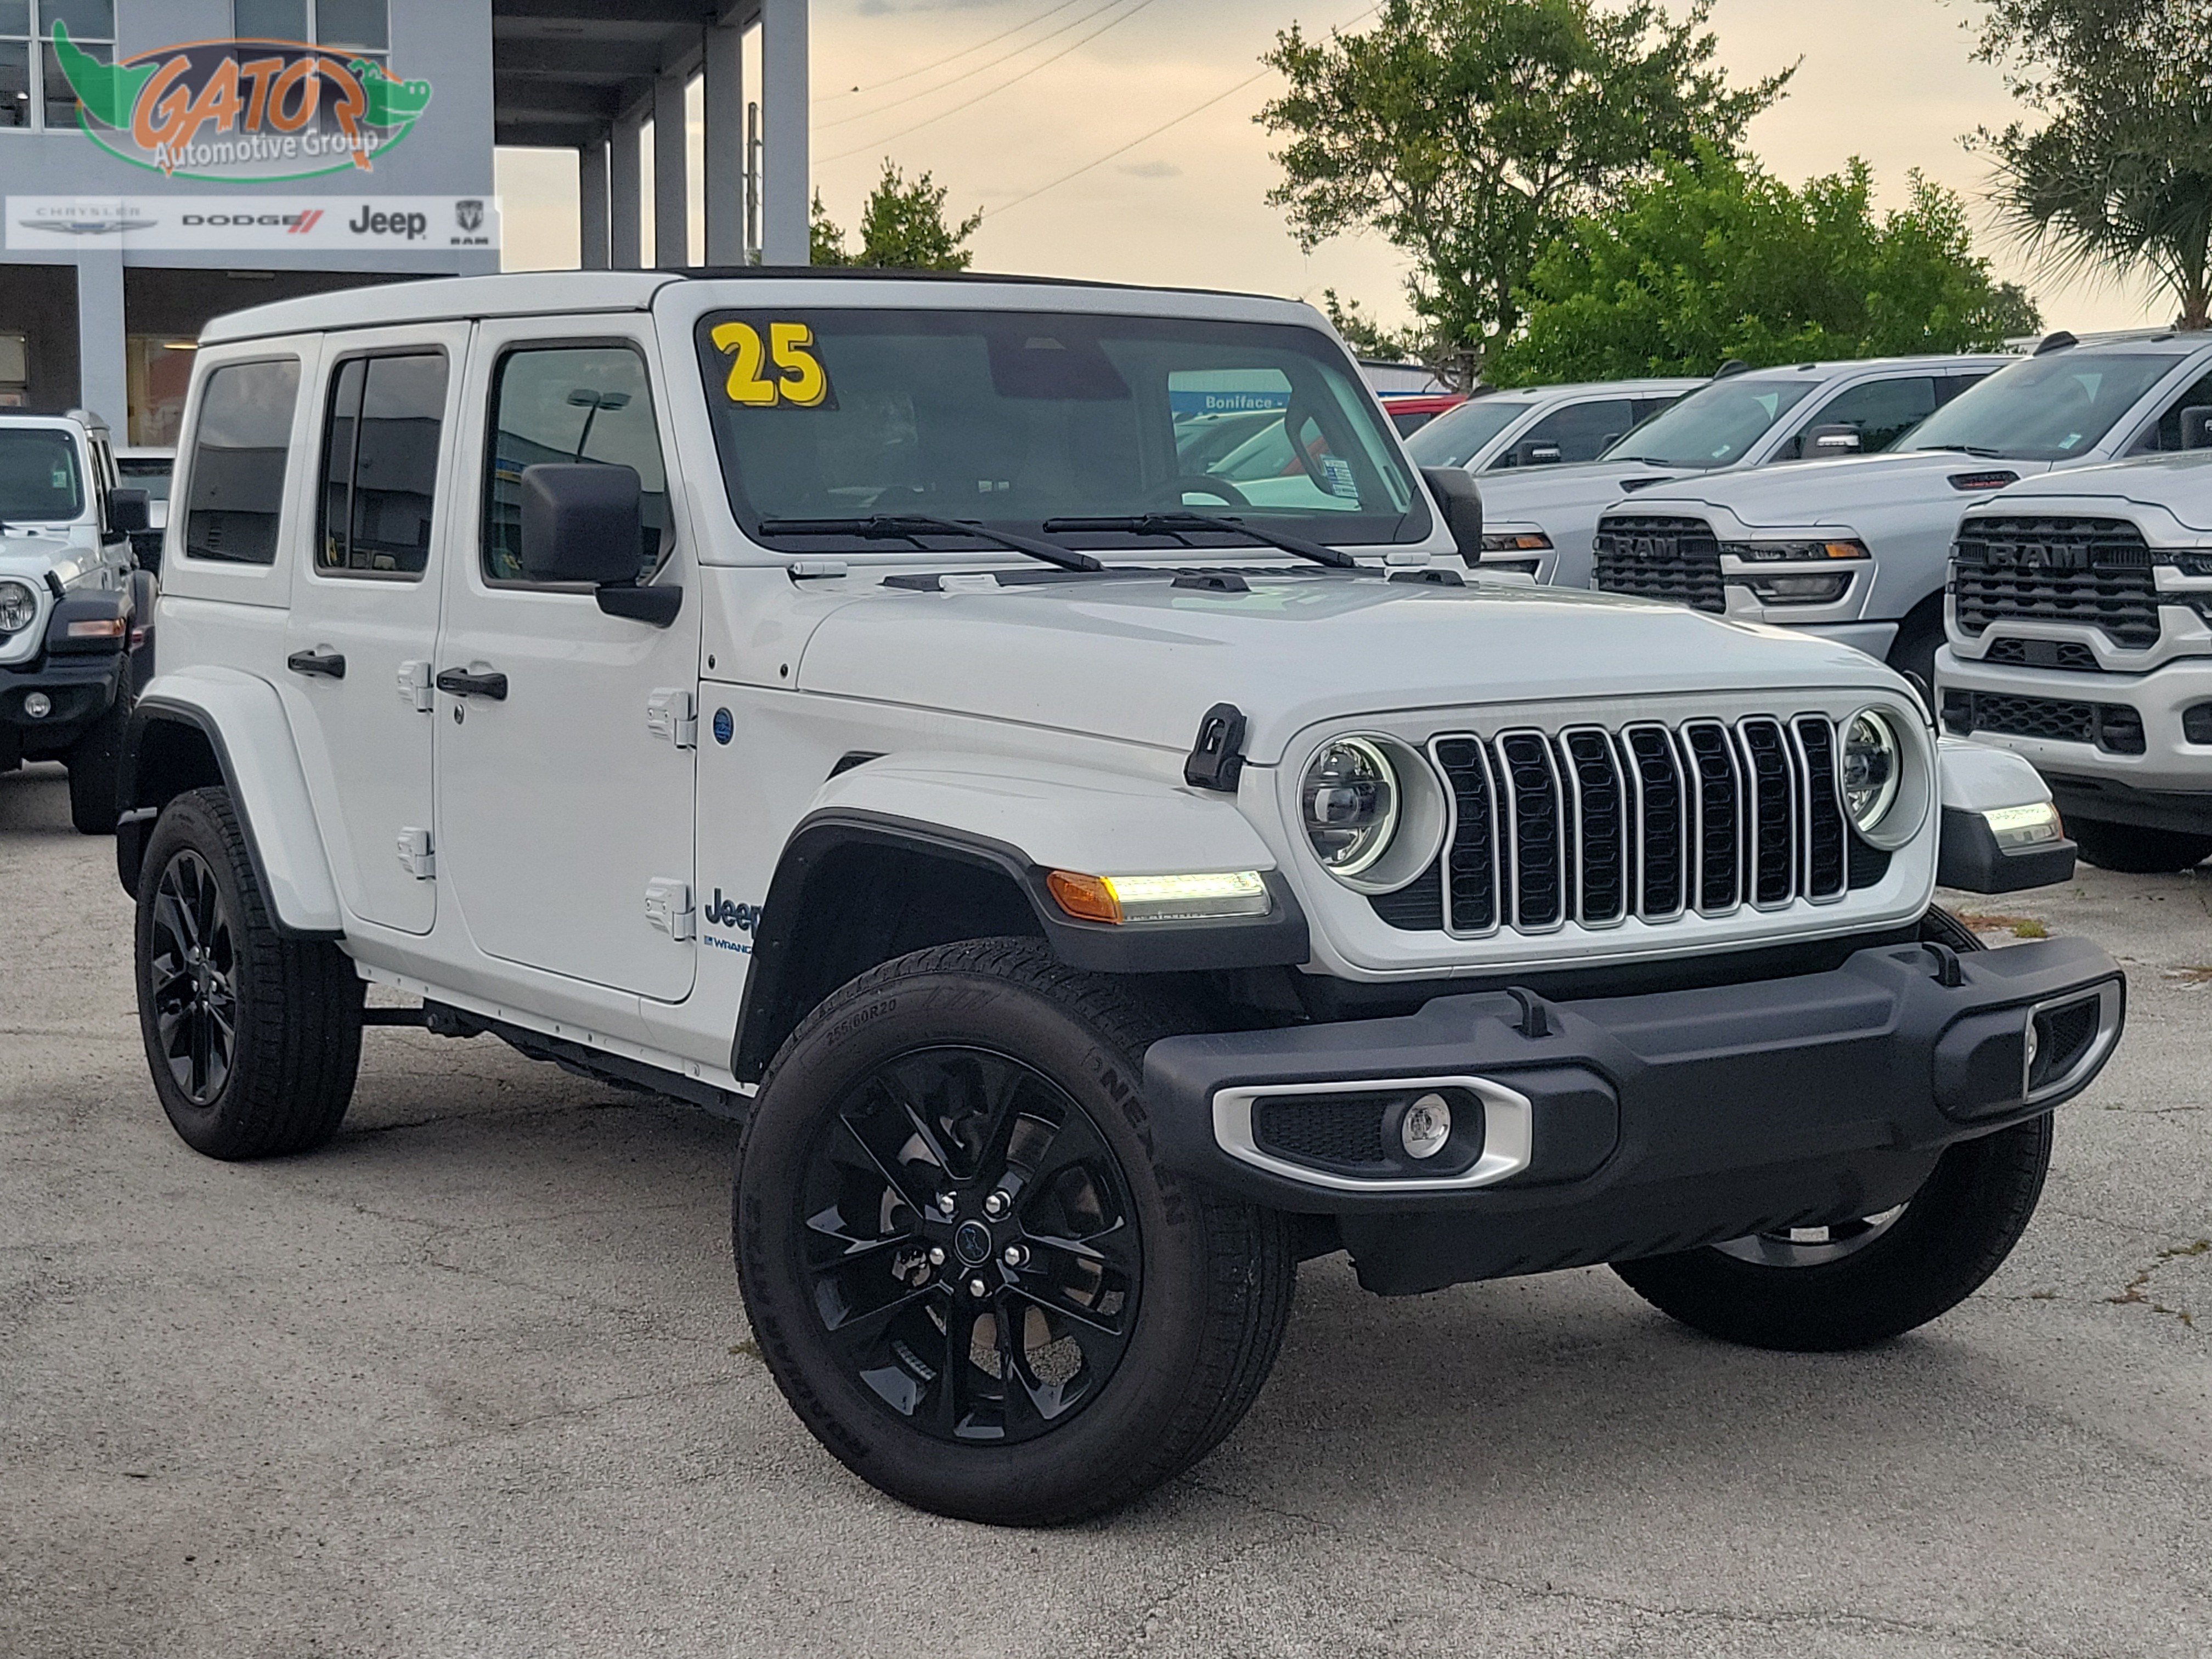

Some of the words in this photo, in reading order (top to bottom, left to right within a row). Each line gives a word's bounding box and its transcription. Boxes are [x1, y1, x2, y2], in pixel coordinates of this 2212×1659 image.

[712, 321, 827, 407] 25
[1206, 395, 1272, 409] Boniface
[1615, 537, 1678, 557] RAM
[1987, 543, 2089, 567] RAM
